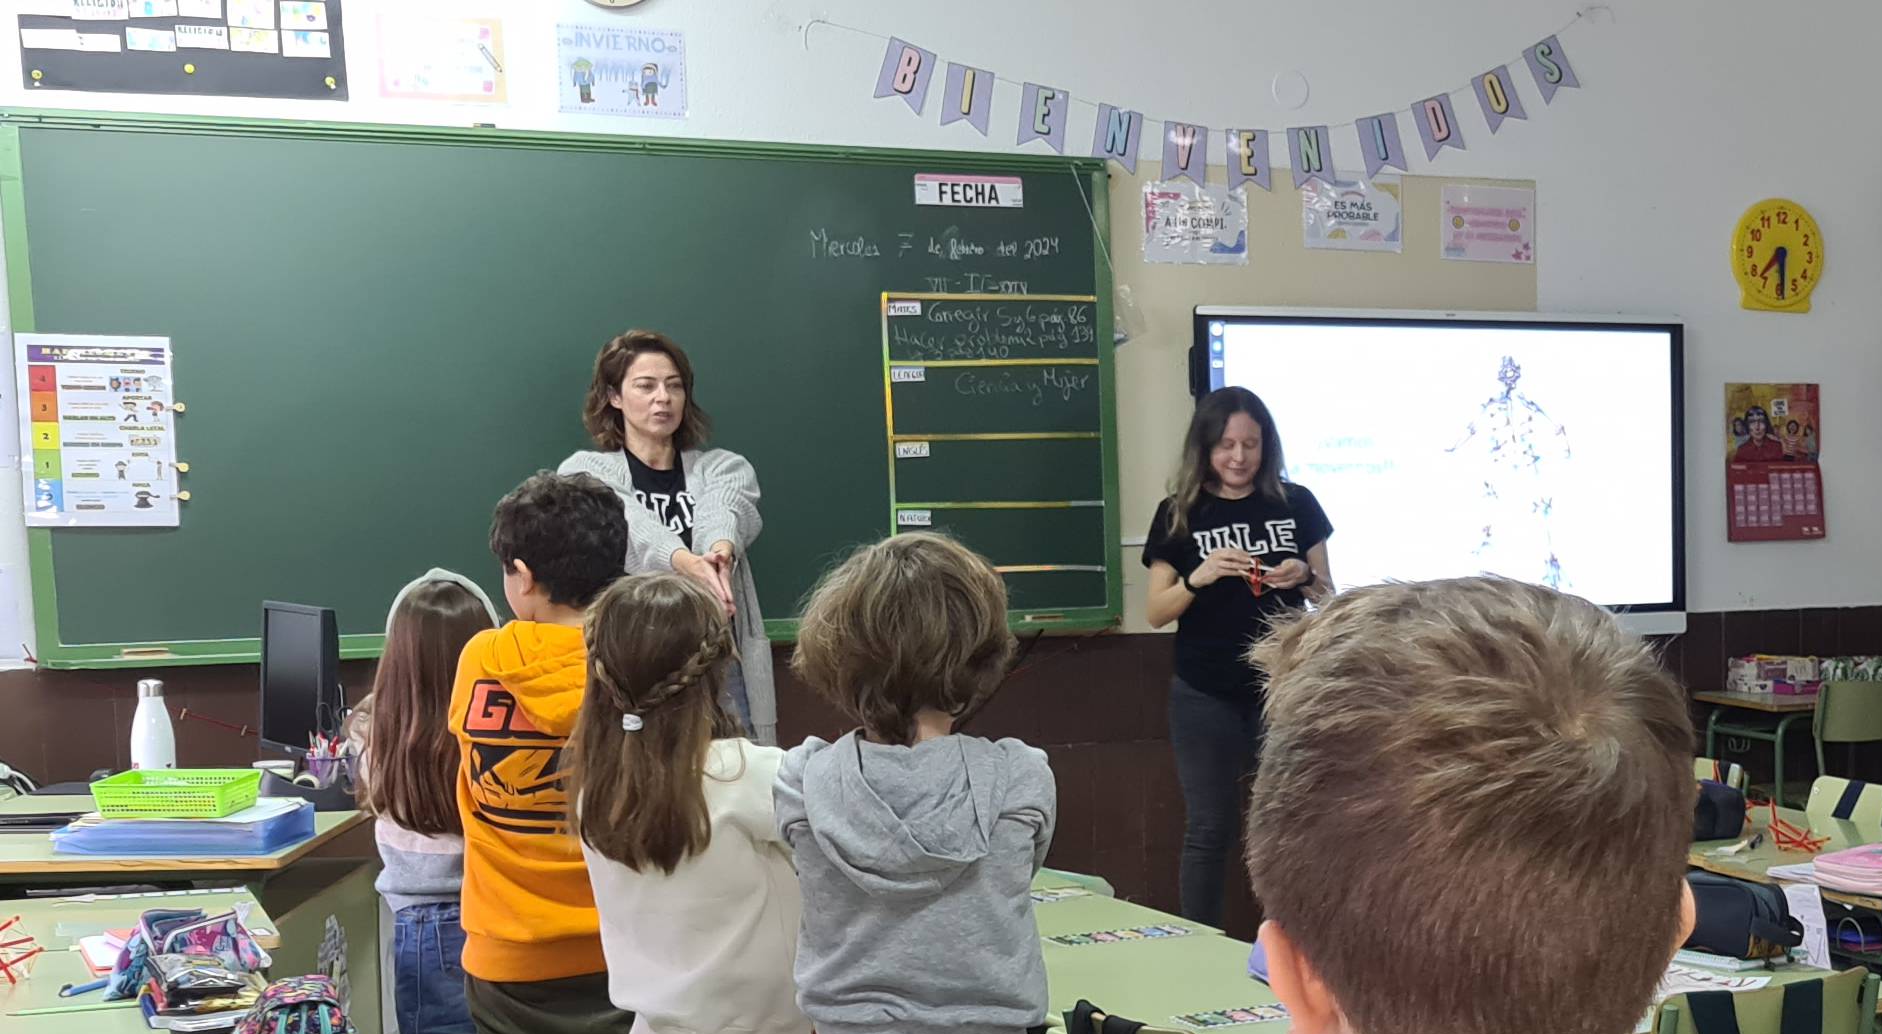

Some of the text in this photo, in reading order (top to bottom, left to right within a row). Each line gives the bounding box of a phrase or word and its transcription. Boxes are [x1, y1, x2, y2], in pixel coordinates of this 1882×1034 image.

[574, 31, 666, 53] INVIERNO
[893, 41, 1564, 178] BIENVENIDOS
[938, 182, 1000, 205] FECHA
[1760, 215, 1771, 229] 11
[1776, 211, 1788, 225] 12
[1794, 218, 1800, 231] 1
[1750, 228, 1762, 242] 10
[1803, 234, 1810, 247] 2
[1746, 245, 1754, 258] 9
[1807, 251, 1814, 264] 3
[1750, 264, 1758, 277] 8
[1800, 268, 1808, 280] 4
[1790, 278, 1798, 292] 5
